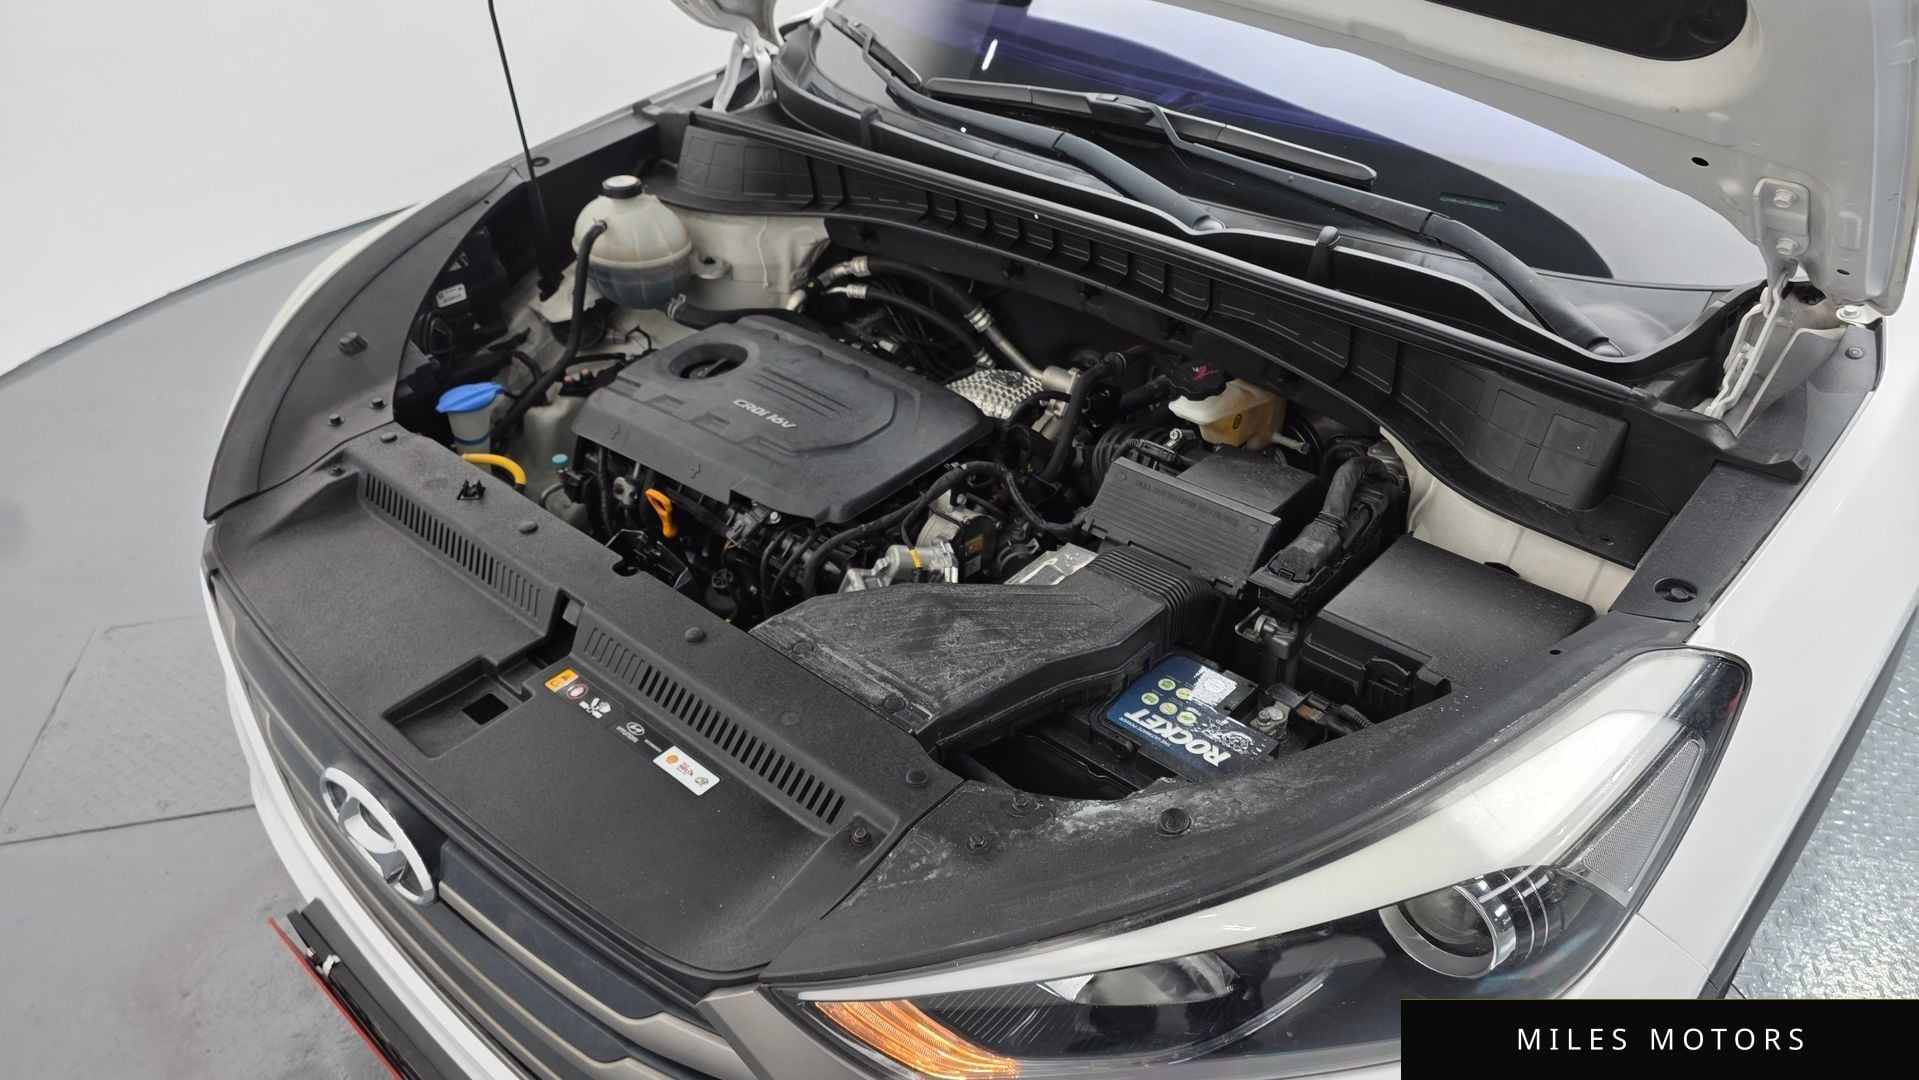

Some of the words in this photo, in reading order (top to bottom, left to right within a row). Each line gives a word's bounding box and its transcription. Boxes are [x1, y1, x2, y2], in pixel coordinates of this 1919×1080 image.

[766, 413, 797, 428] 16V
[1118, 716, 1137, 729] POWER
[1124, 708, 1231, 767] ROCKET
[1136, 725, 1161, 743] ULTIMATE
